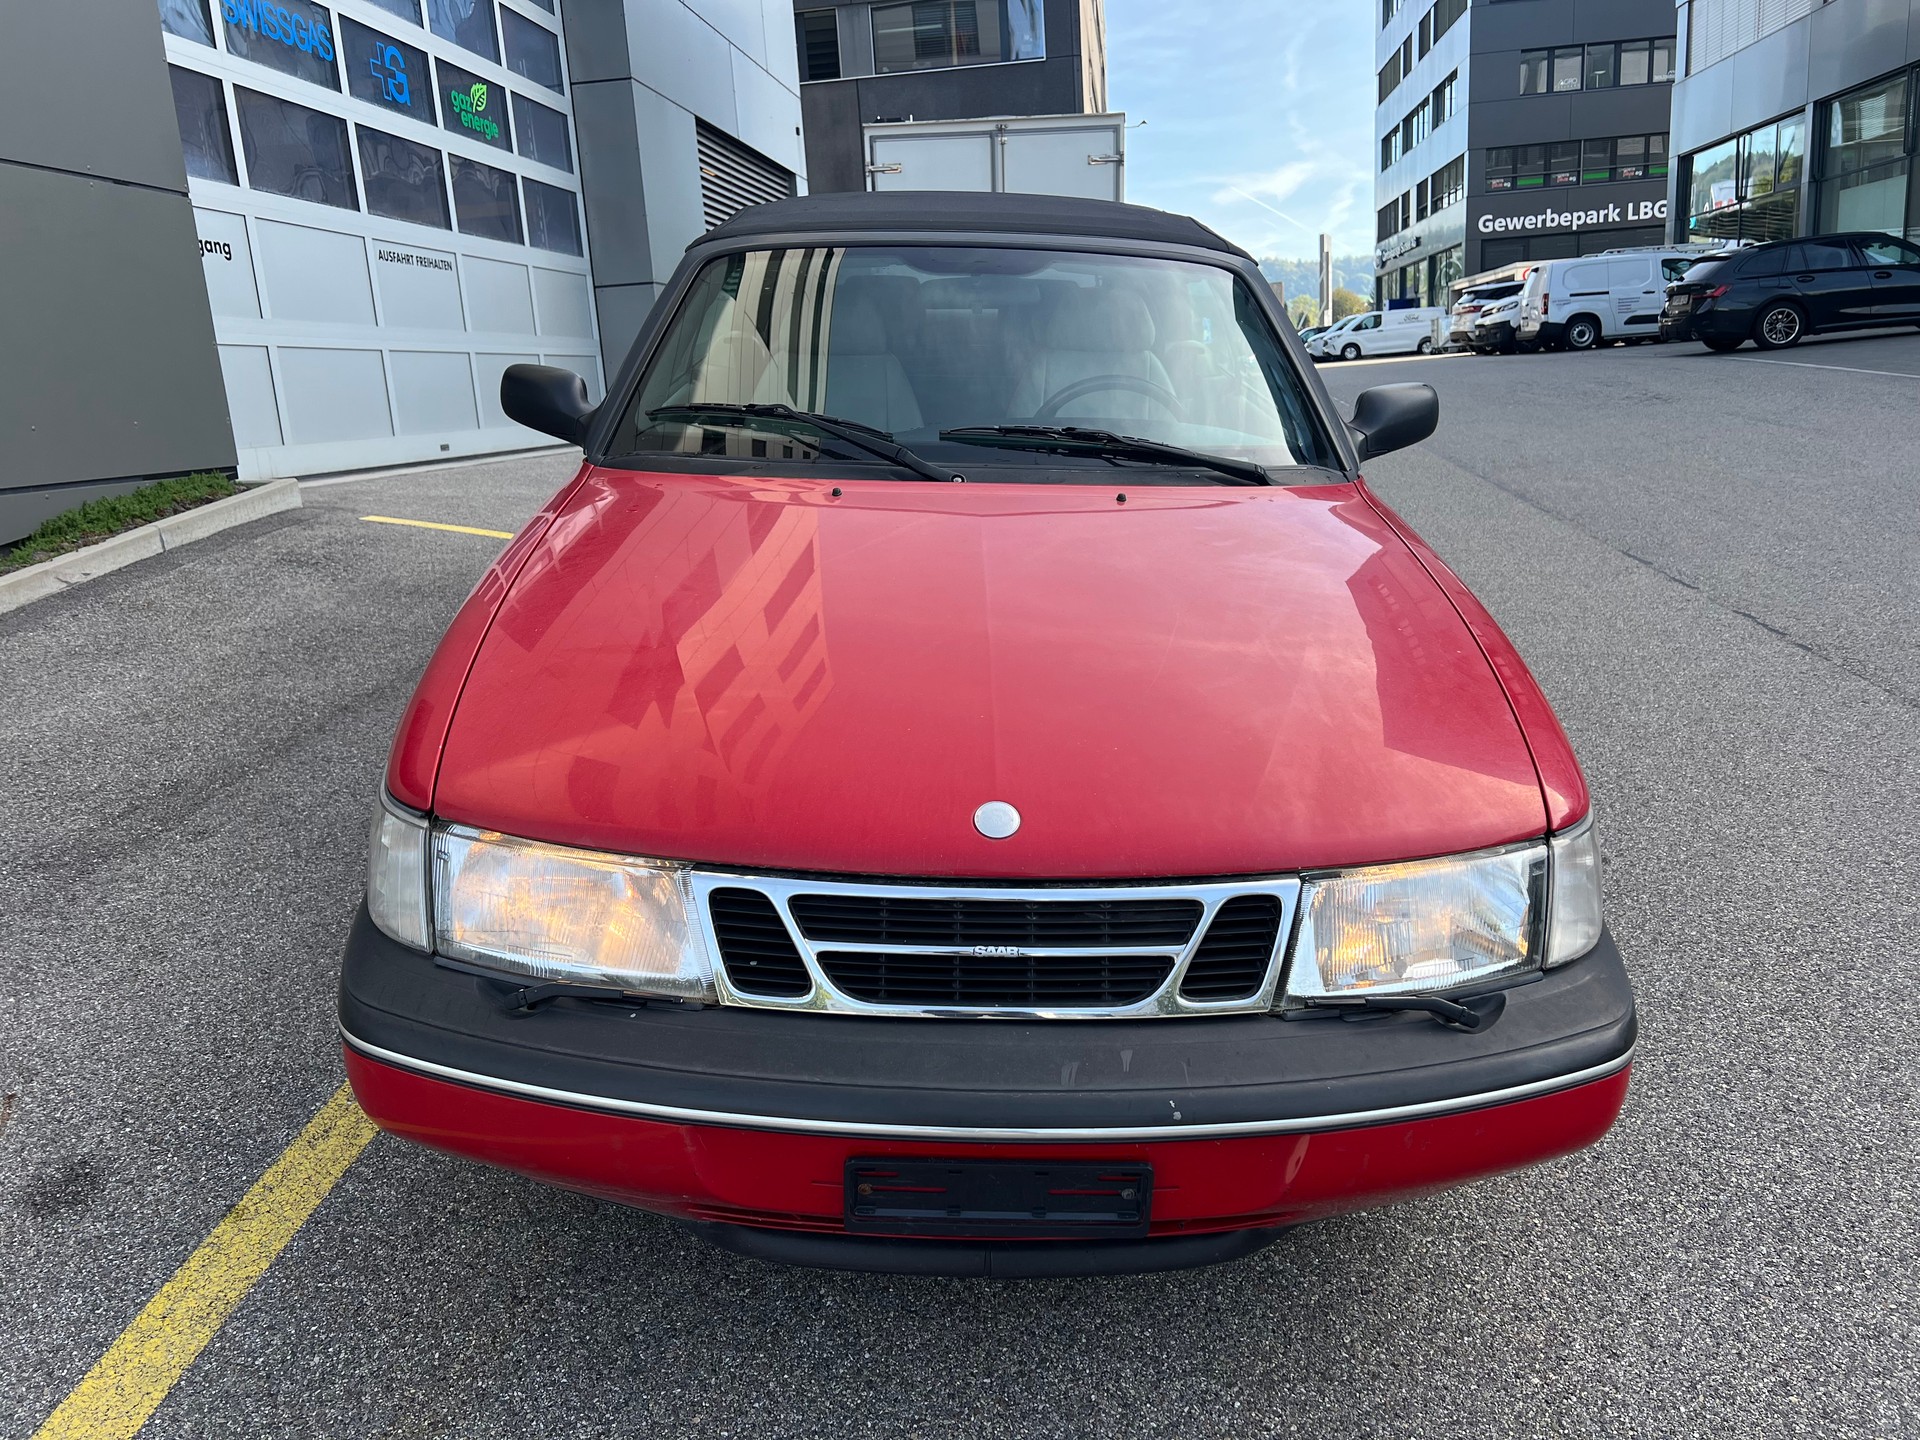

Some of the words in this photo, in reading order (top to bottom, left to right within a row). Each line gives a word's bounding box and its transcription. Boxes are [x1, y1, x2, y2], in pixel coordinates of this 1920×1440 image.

[221, 0, 334, 62] SWISSGAS
[451, 90, 473, 113] gaz
[461, 111, 499, 140] energie
[1477, 204, 1621, 233] Gewerbepark
[1627, 200, 1668, 221] LBG
[378, 249, 415, 266] AUSFAHRT
[415, 255, 453, 272] FREIHALTEN
[974, 945, 1019, 958] SAAB
